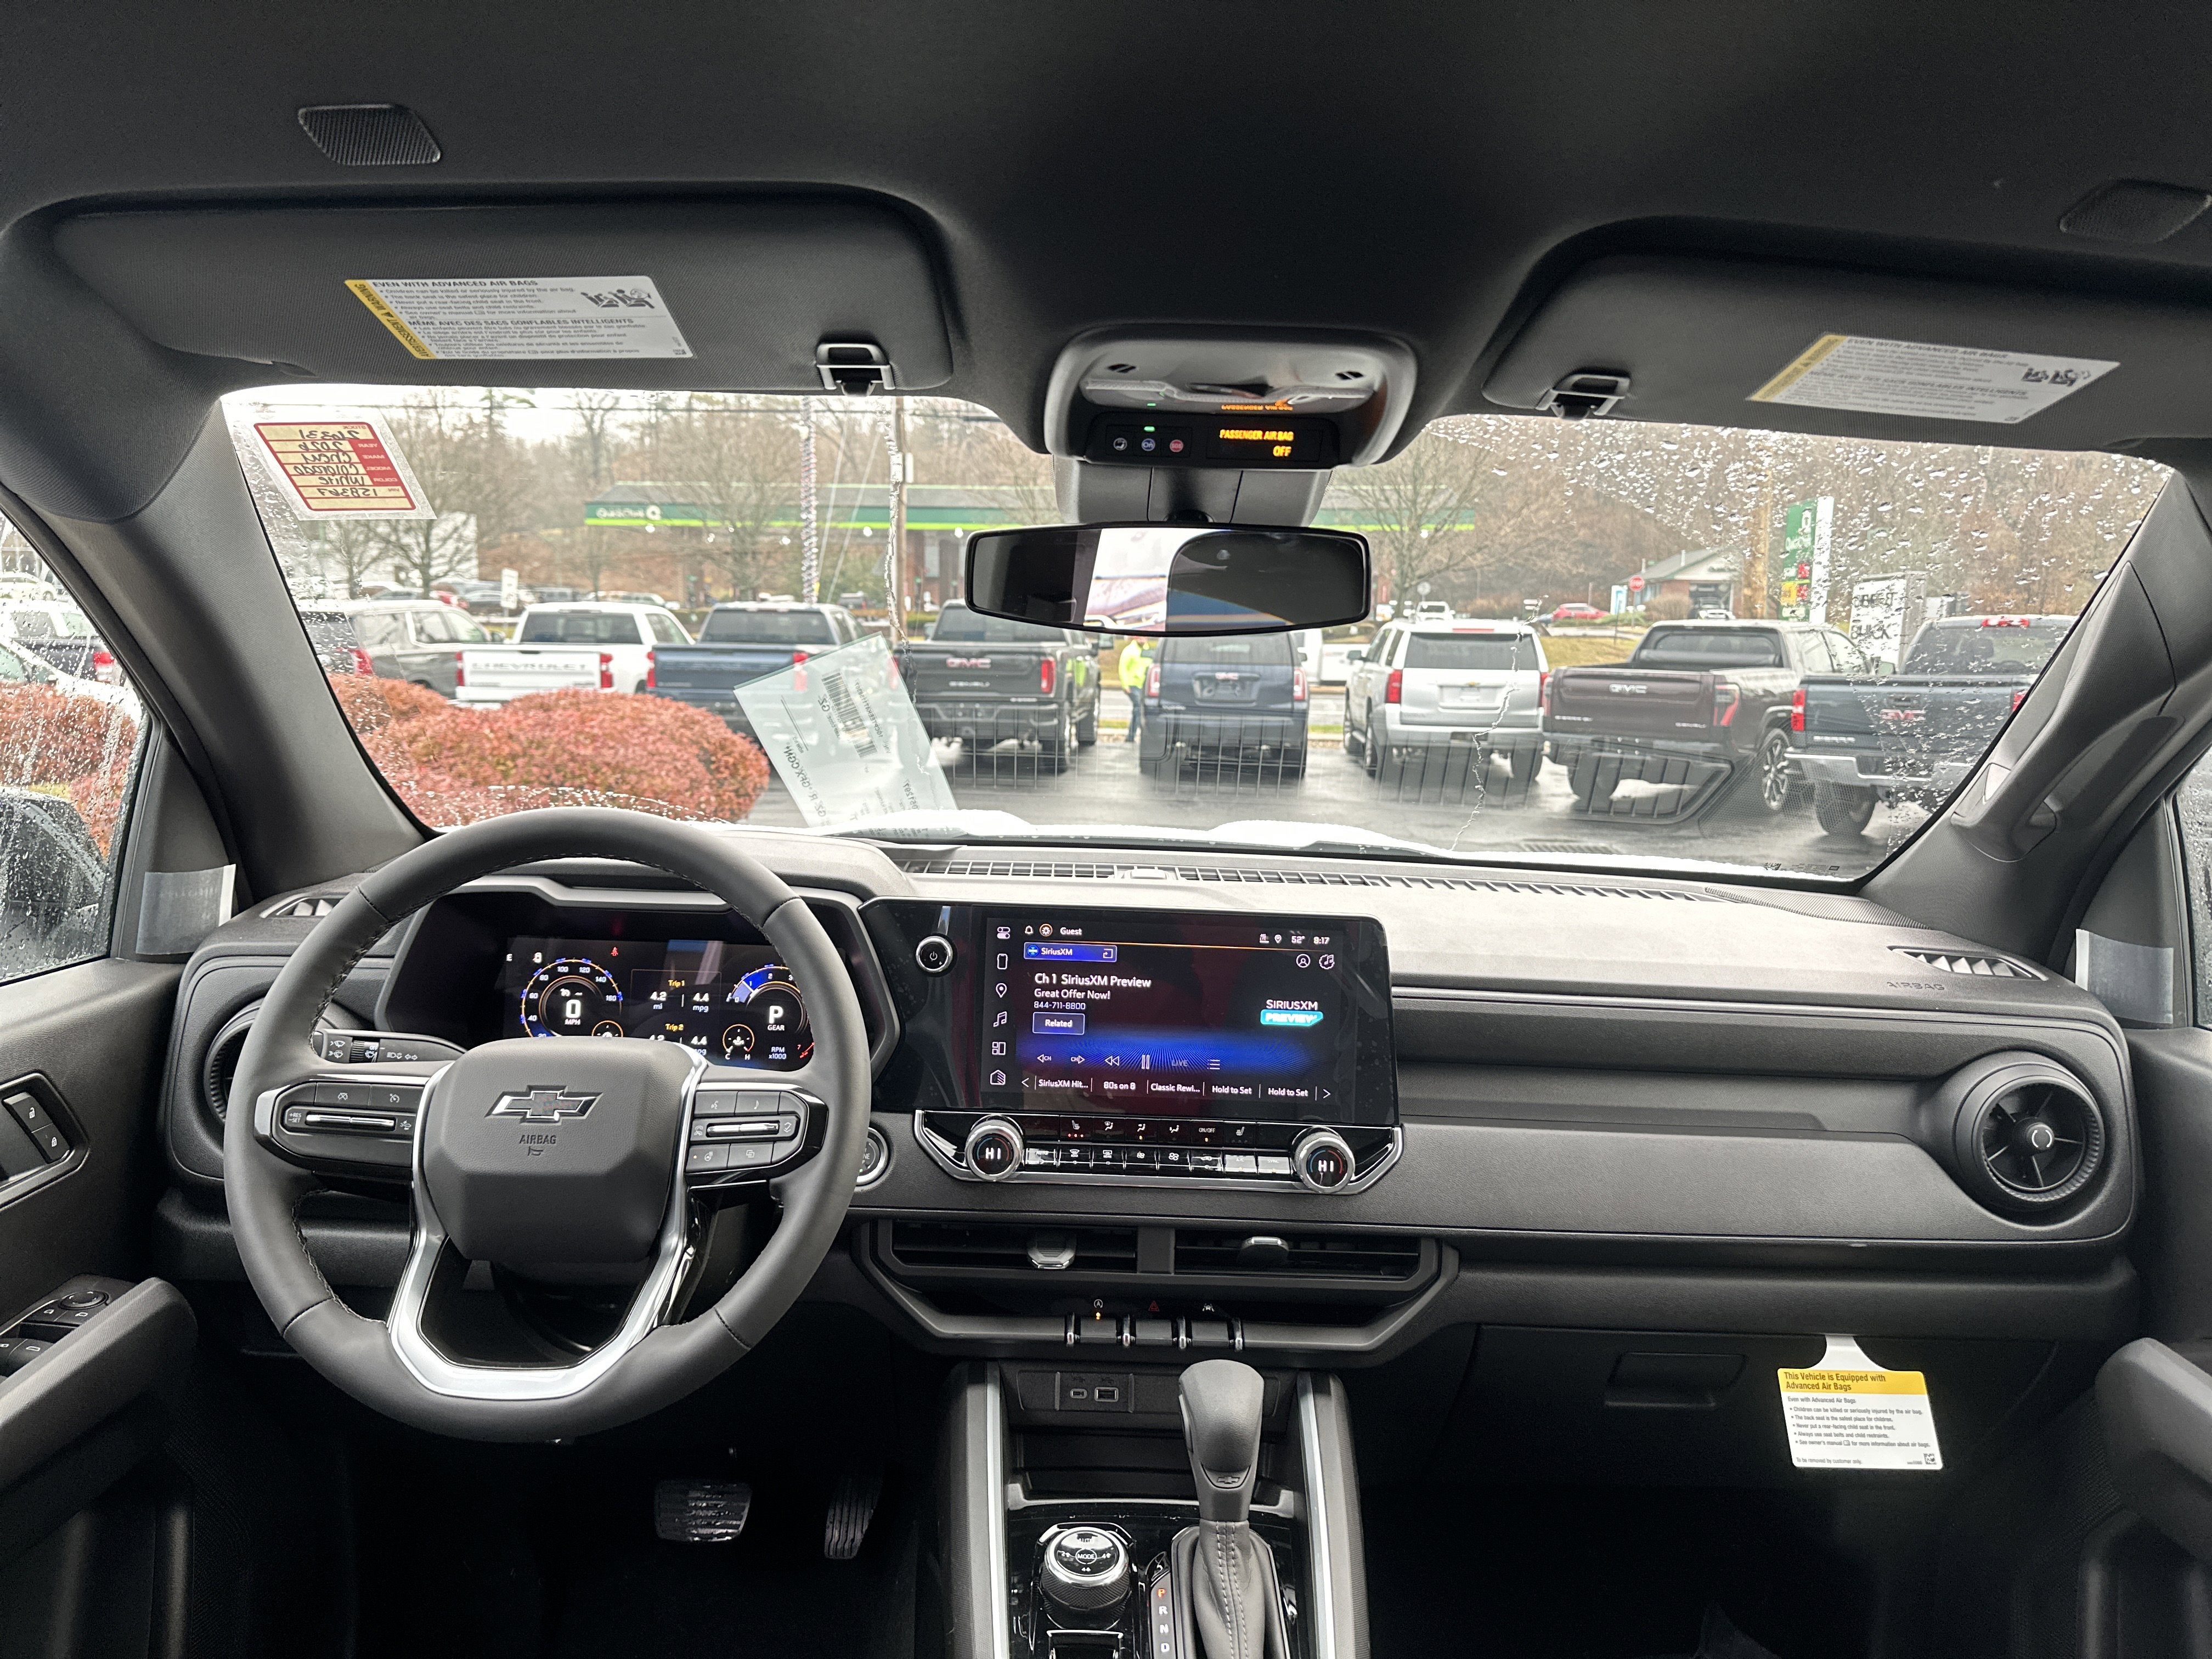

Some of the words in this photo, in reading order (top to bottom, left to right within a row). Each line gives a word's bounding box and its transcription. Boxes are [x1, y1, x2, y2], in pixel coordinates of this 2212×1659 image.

[1220, 430, 1262, 439] PASSENGER
[1264, 431, 1277, 440] AIR
[1277, 431, 1294, 441] BAG
[1273, 445, 1291, 456] OFF
[946, 658, 991, 668] GMC
[1609, 684, 1647, 693] GMC
[1060, 927, 1082, 935] Guest
[1291, 935, 1306, 944] 52°
[1313, 936, 1330, 945] 8:17
[1041, 947, 1073, 956] SiriusXM
[1035, 973, 1049, 984] Ch
[1052, 973, 1057, 984] 1
[1061, 974, 1108, 986] SiriusXM
[1110, 975, 1152, 988] Preview
[1887, 981, 1945, 991] AIRBAG
[650, 991, 667, 1001] 4.2
[693, 992, 709, 1002] 4.4
[1034, 988, 1059, 998] Great
[1060, 989, 1085, 998] Offer
[1087, 990, 1111, 1000] Now!
[566, 999, 582, 1018] 0
[1034, 1001, 1086, 1010] 844-711-8800
[1266, 999, 1318, 1011] SIRIUSXM
[769, 1005, 783, 1024] P
[1265, 1013, 1317, 1023] PREVIEW
[665, 1023, 678, 1032] Trip
[1045, 1019, 1073, 1028] Related
[691, 1036, 707, 1045] 4.4
[1038, 1079, 1070, 1087] SiriusXM
[1071, 1080, 1088, 1088] Hit...
[1176, 1084, 1200, 1092] Rewi...
[1212, 1085, 1229, 1093] Hold
[1268, 1087, 1285, 1096] Hold
[1295, 1088, 1308, 1097] Set
[519, 1134, 556, 1145] AIRBAG
[985, 1147, 1001, 1160] HI
[1318, 1160, 1334, 1172] HI
[1784, 1372, 1799, 1380] This
[1836, 1373, 1868, 1383] Equipped
[1786, 1381, 1820, 1390] Advanced
[1822, 1382, 1832, 1390] Air
[1833, 1383, 1852, 1392] Bags
[1158, 1588, 1166, 1598] P
[1159, 1606, 1168, 1615] R
[1160, 1624, 1169, 1634] N
[1161, 1643, 1170, 1652] D
